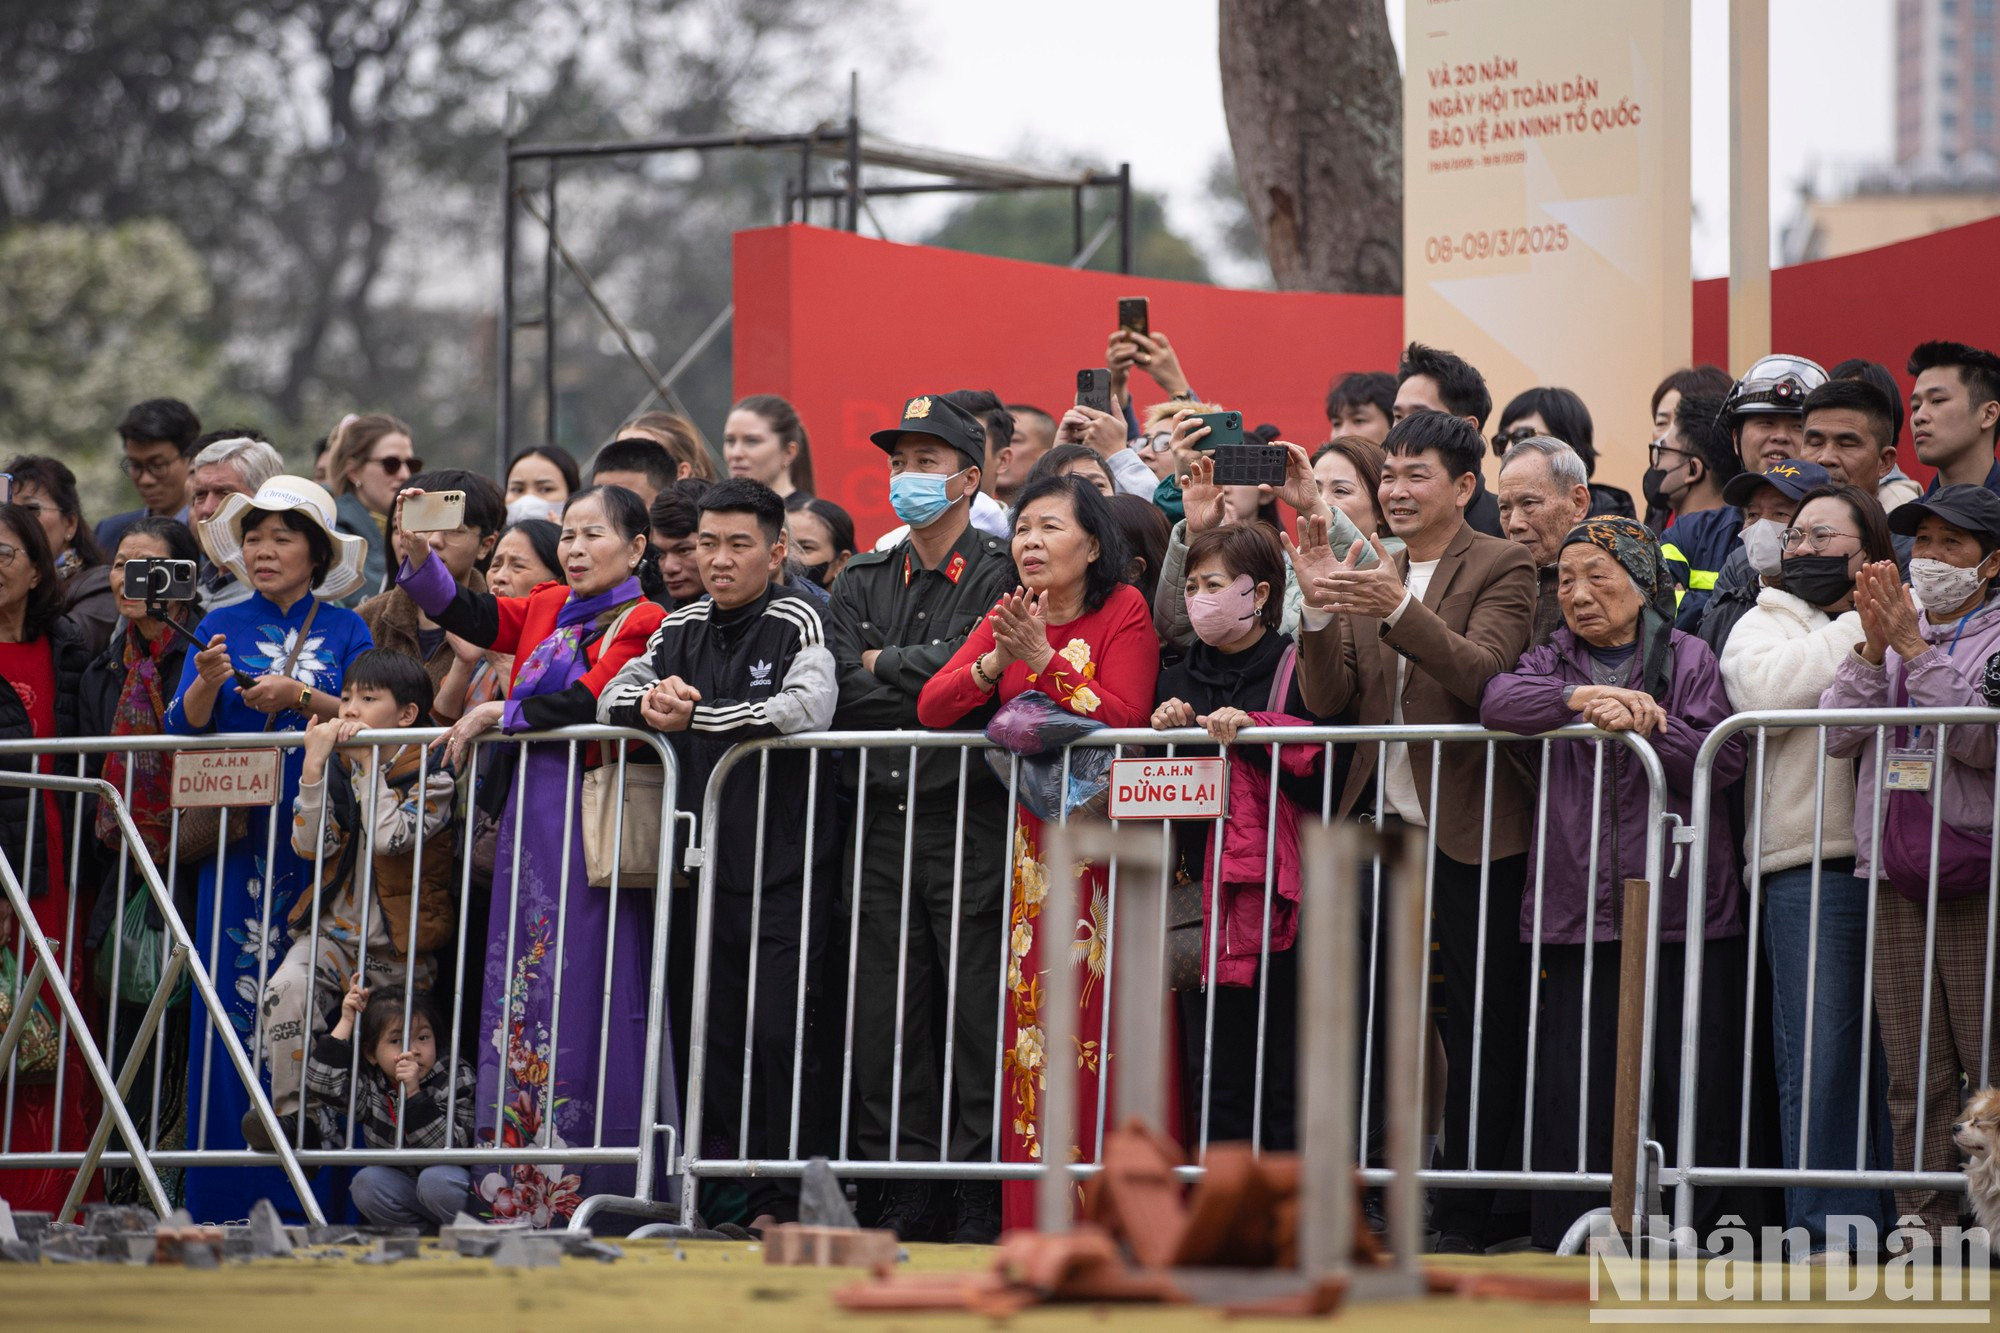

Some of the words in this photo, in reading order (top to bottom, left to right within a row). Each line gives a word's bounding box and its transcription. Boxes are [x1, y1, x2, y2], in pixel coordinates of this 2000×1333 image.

[1428, 61, 1451, 88] VÀ
[1454, 64, 1476, 86] 20
[1480, 56, 1518, 83] NĂM
[1428, 90, 1475, 119] NGÀY
[1478, 86, 1508, 117] HỘI
[1511, 80, 1557, 109] TOÀN
[1467, 118, 1487, 150] VỆ
[1492, 121, 1514, 142] AN
[1519, 114, 1561, 138] NINH
[1564, 100, 1588, 133] TỔ
[1590, 96, 1641, 134] QUỐC
[1425, 224, 1569, 264] 08-09/3/2025
[202, 756, 249, 768] C.A.H.N
[1143, 765, 1193, 777] C.A.H.N
[179, 771, 233, 793] DỪNG
[237, 773, 269, 794] LẠI
[1119, 779, 1177, 802] DỪNG
[1182, 784, 1215, 805] LẠI
